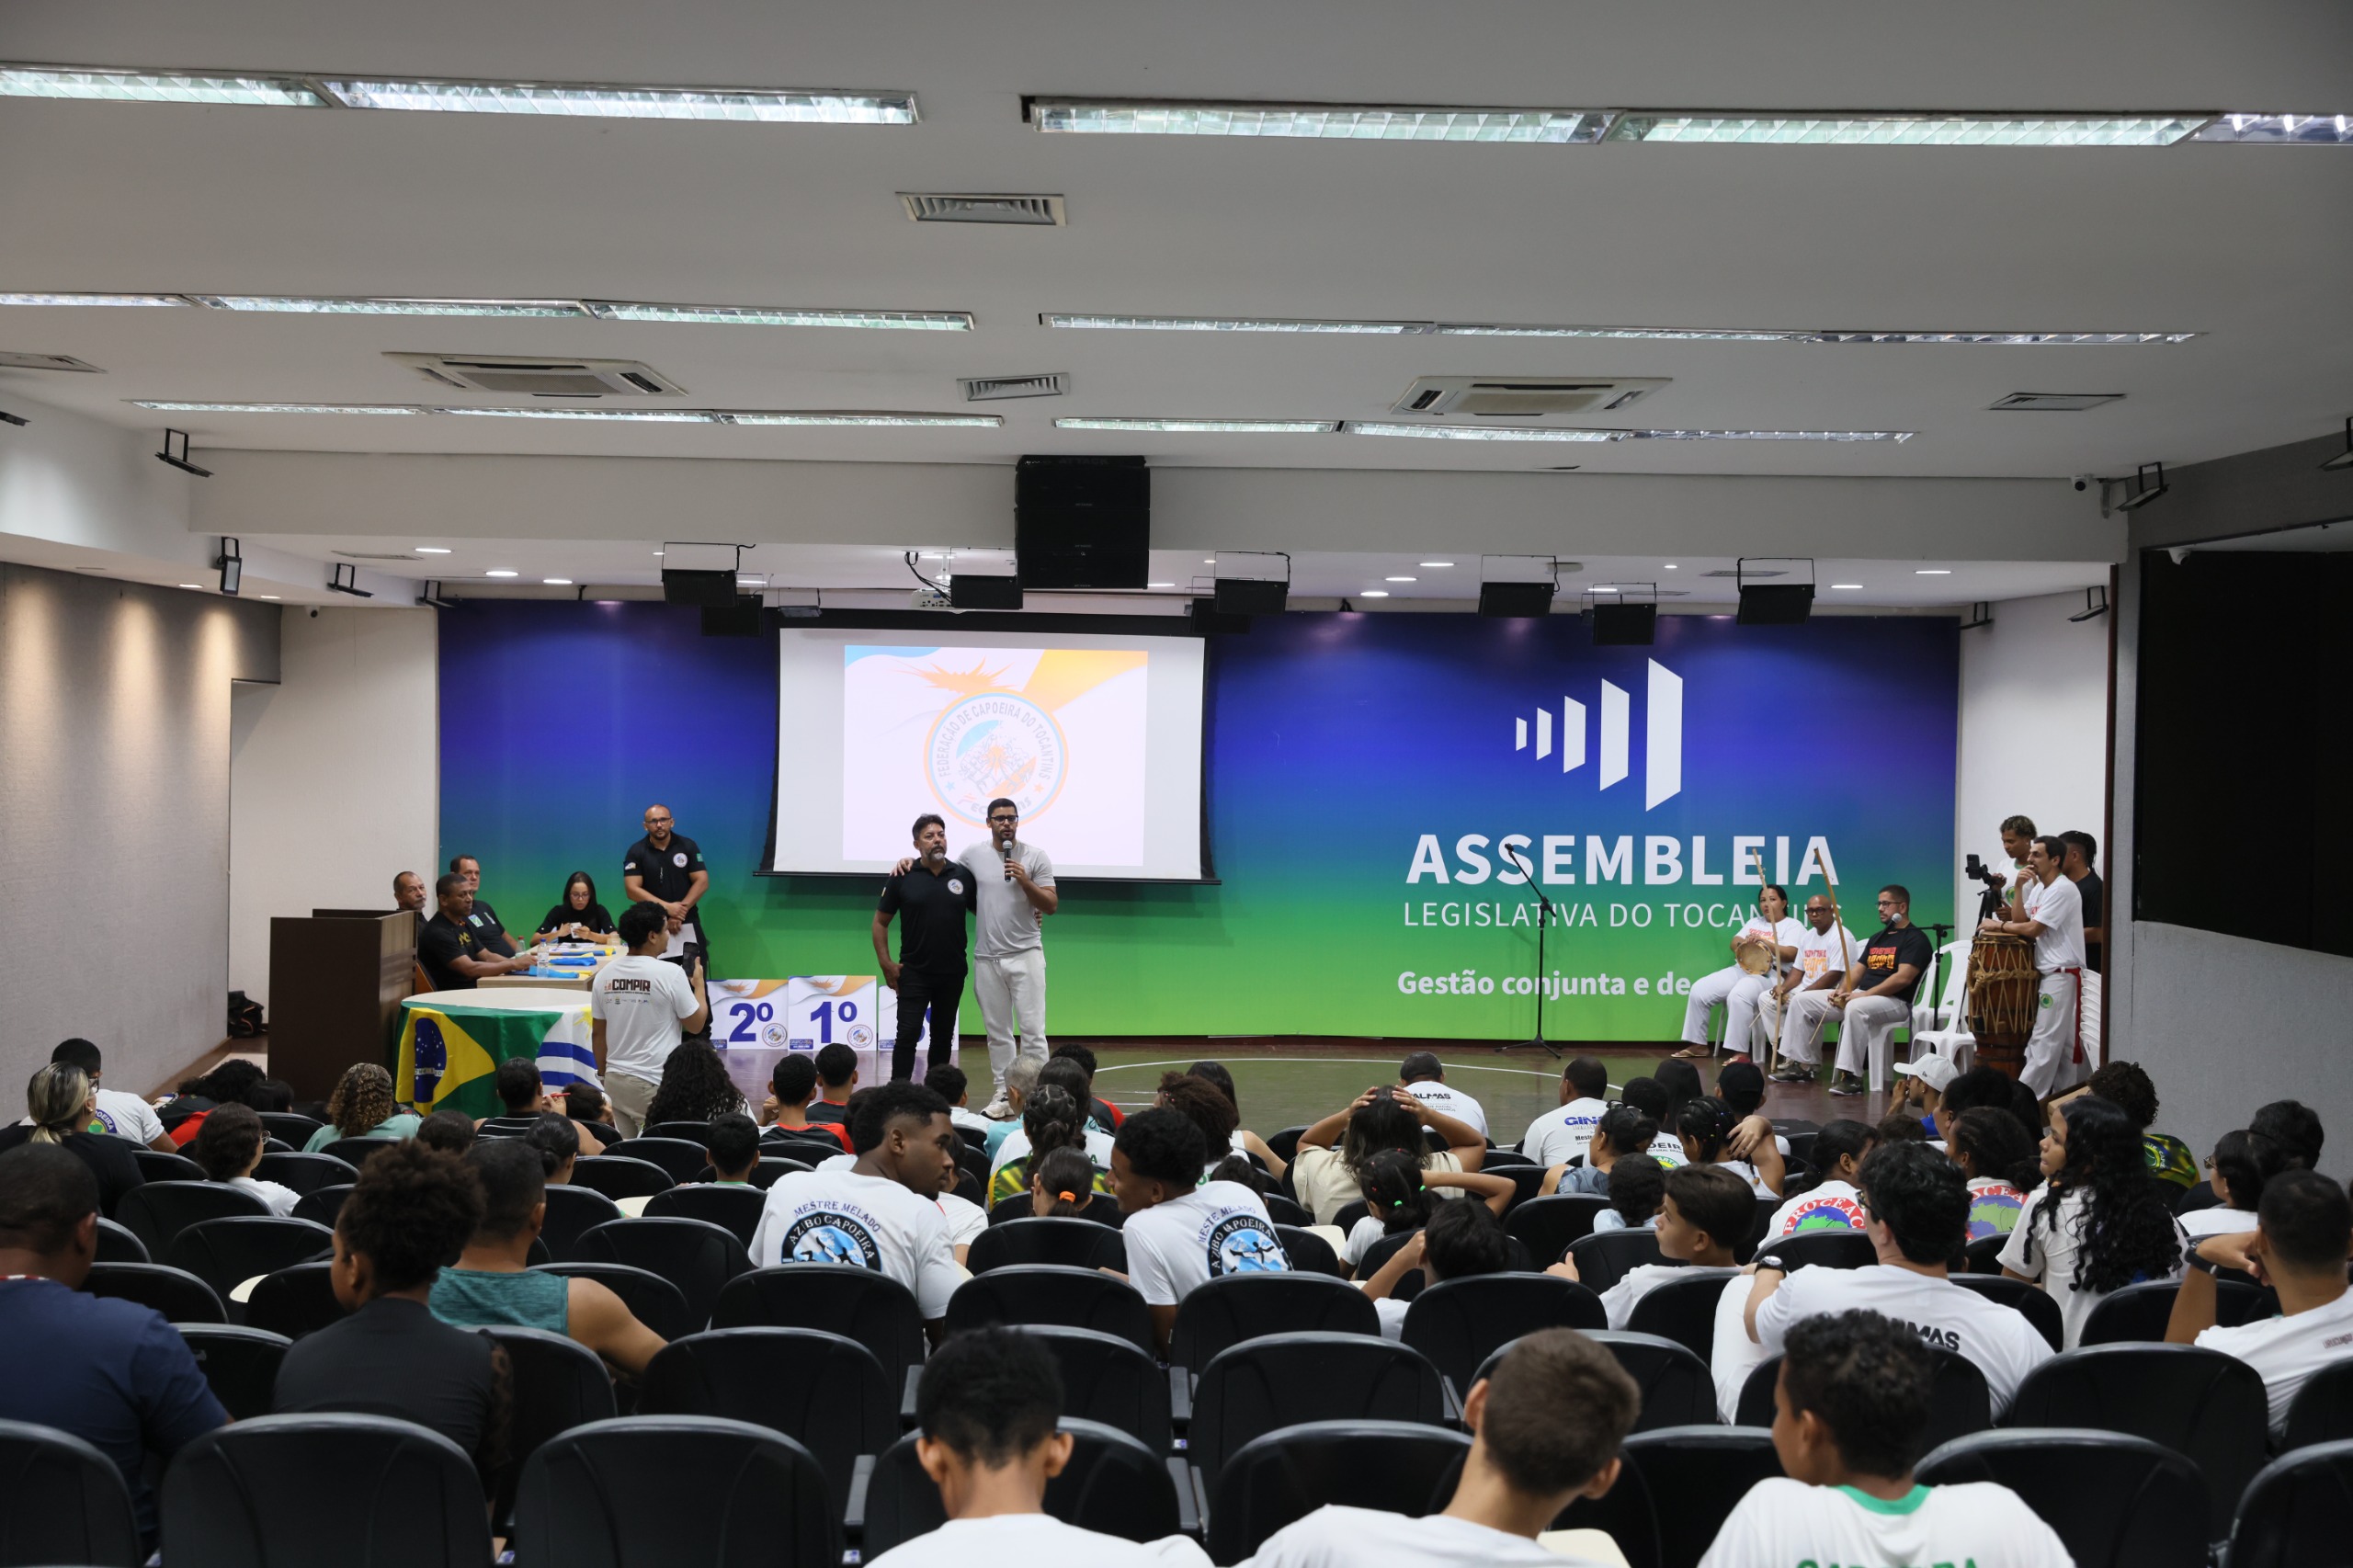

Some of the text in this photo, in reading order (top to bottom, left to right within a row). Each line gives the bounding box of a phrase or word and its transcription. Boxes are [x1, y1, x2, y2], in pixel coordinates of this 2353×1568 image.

[936, 701, 1054, 780] FEDERAÇÃO DE CAPOEIRA DO TOCANTINS
[1404, 833, 1839, 885] ASSEMBLEIA
[1404, 902, 1598, 927] LEGISLATIVA
[1608, 903, 1653, 928] DO
[612, 979, 651, 992] COMPIR
[1397, 969, 1495, 995] Gestão
[1501, 970, 1626, 1001] conjunta
[1632, 975, 1650, 995] e
[96, 1110, 115, 1131] OEIRA
[793, 1200, 881, 1233] MESTRE MELADO
[824, 1214, 876, 1260] CAPOEIRA
